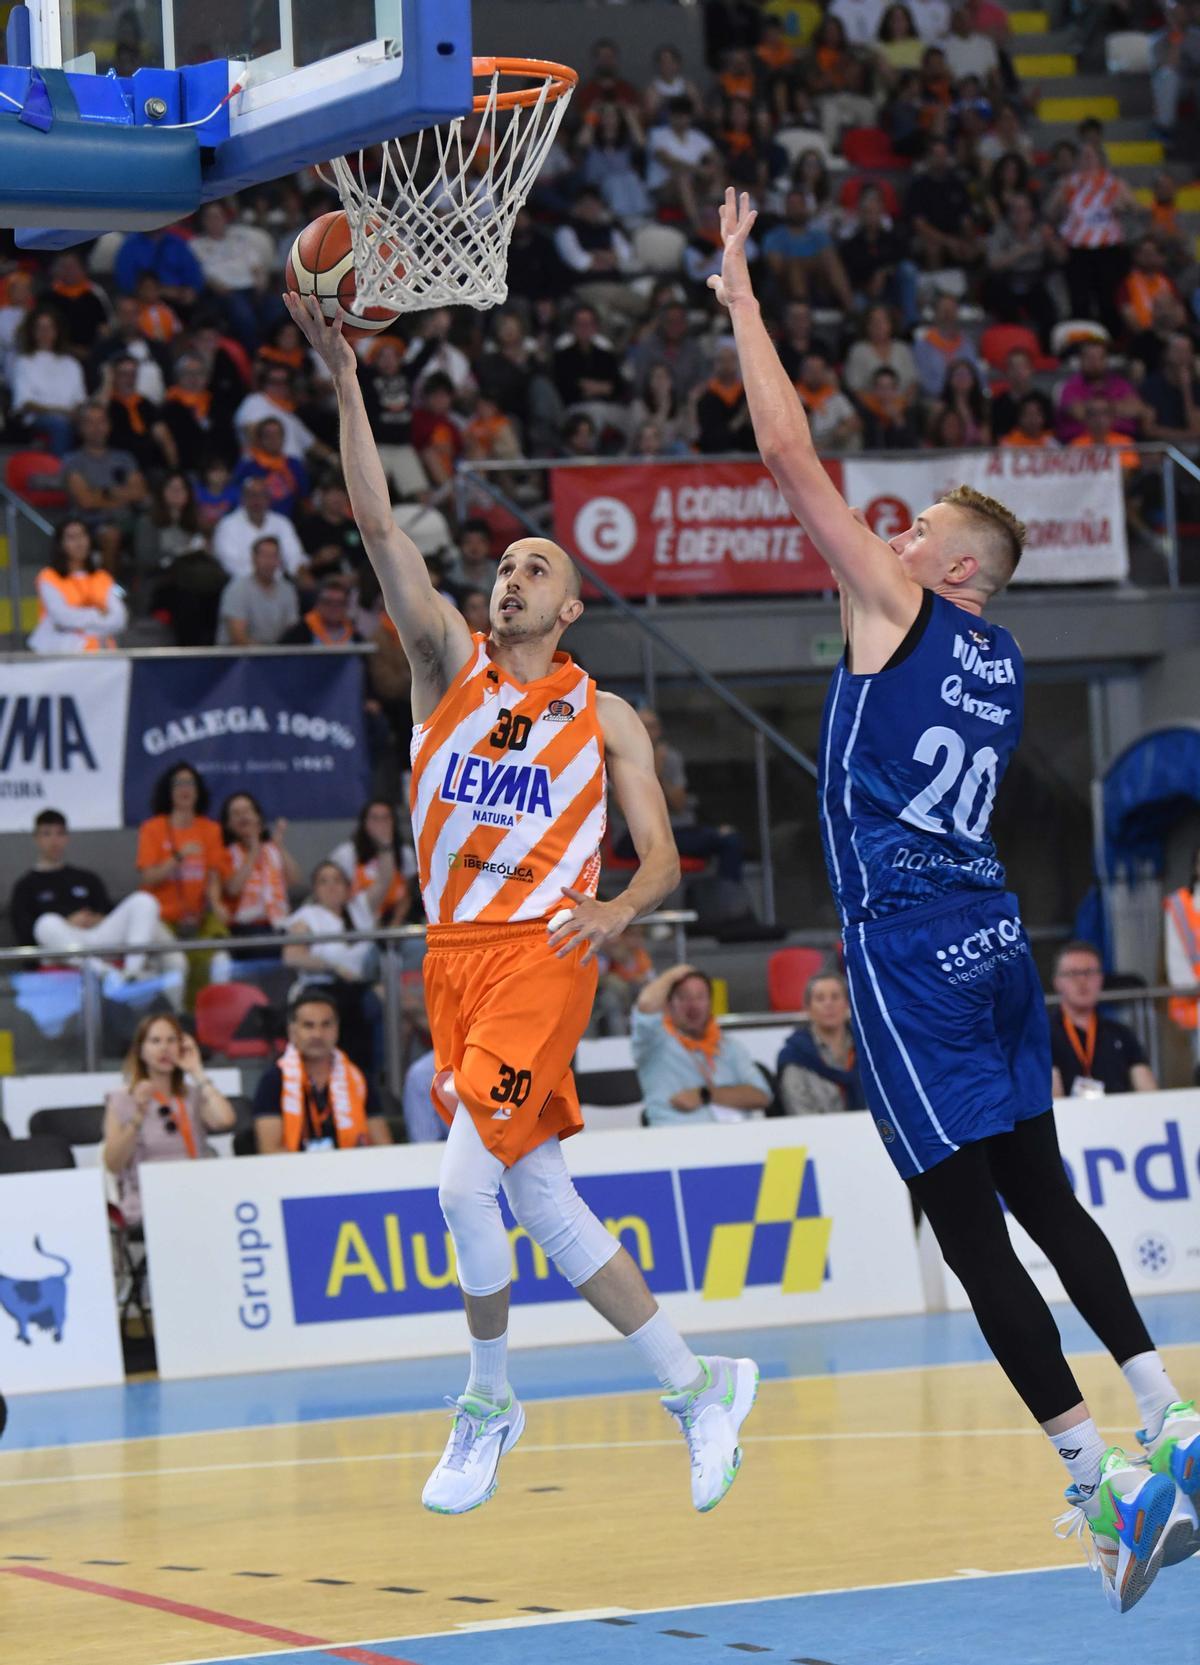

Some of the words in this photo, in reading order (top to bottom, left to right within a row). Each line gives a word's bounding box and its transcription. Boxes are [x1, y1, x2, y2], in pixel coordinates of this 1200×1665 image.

[653, 487, 673, 520] A
[677, 478, 797, 522] CORUÑA
[655, 519, 674, 565] É
[677, 525, 804, 564] DEPORTE
[0, 695, 99, 772] MA
[142, 706, 270, 756] GALEGA
[276, 711, 356, 751] 100%
[490, 708, 533, 751] 30
[441, 752, 552, 818] LEYMA
[896, 726, 999, 842] 20
[472, 810, 514, 827] NATURA
[464, 858, 534, 879] IBEREÓLICA
[490, 1063, 532, 1108] 30
[235, 1202, 270, 1330] Grupo
